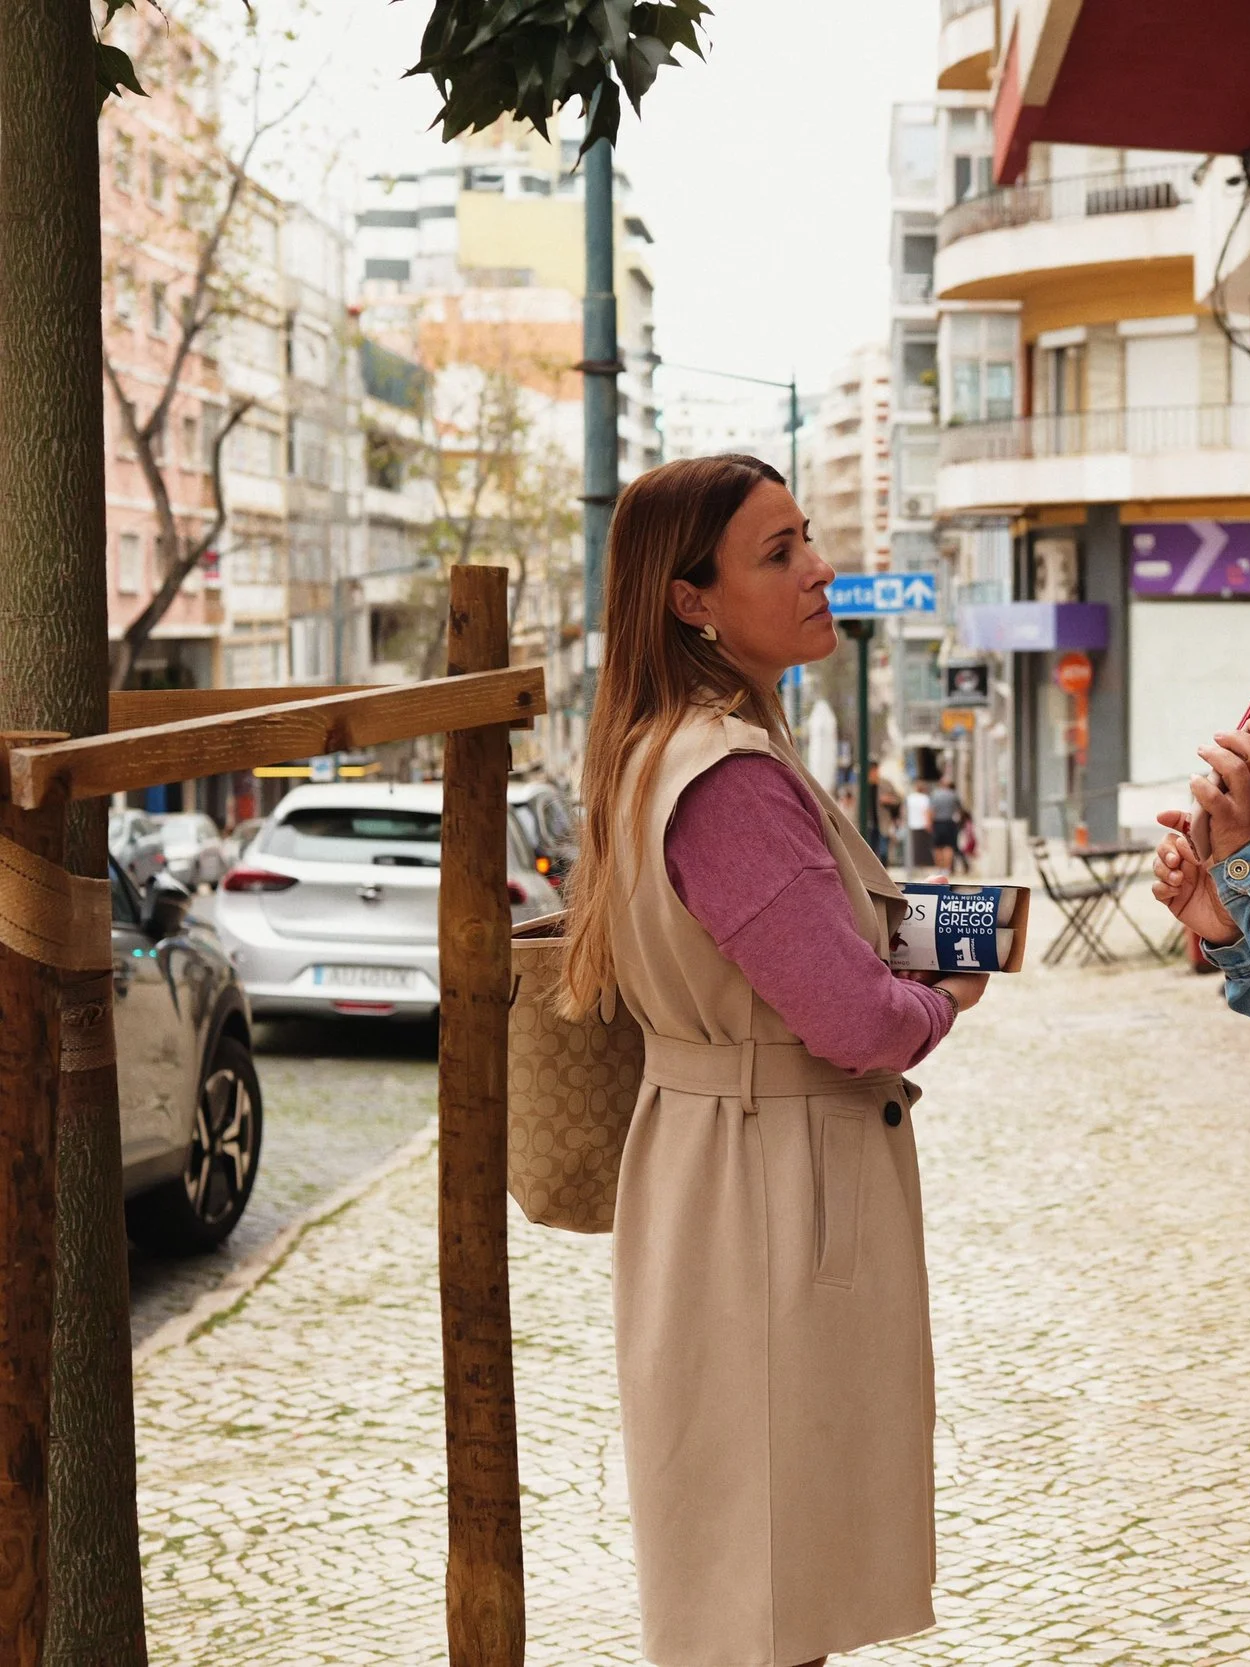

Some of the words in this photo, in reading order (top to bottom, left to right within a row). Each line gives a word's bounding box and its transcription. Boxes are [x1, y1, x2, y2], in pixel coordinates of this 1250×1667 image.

[940, 901, 994, 913] MELHOR
[939, 912, 994, 927] GREGO
[957, 927, 993, 935] MUNDO
[954, 937, 981, 967] 1
